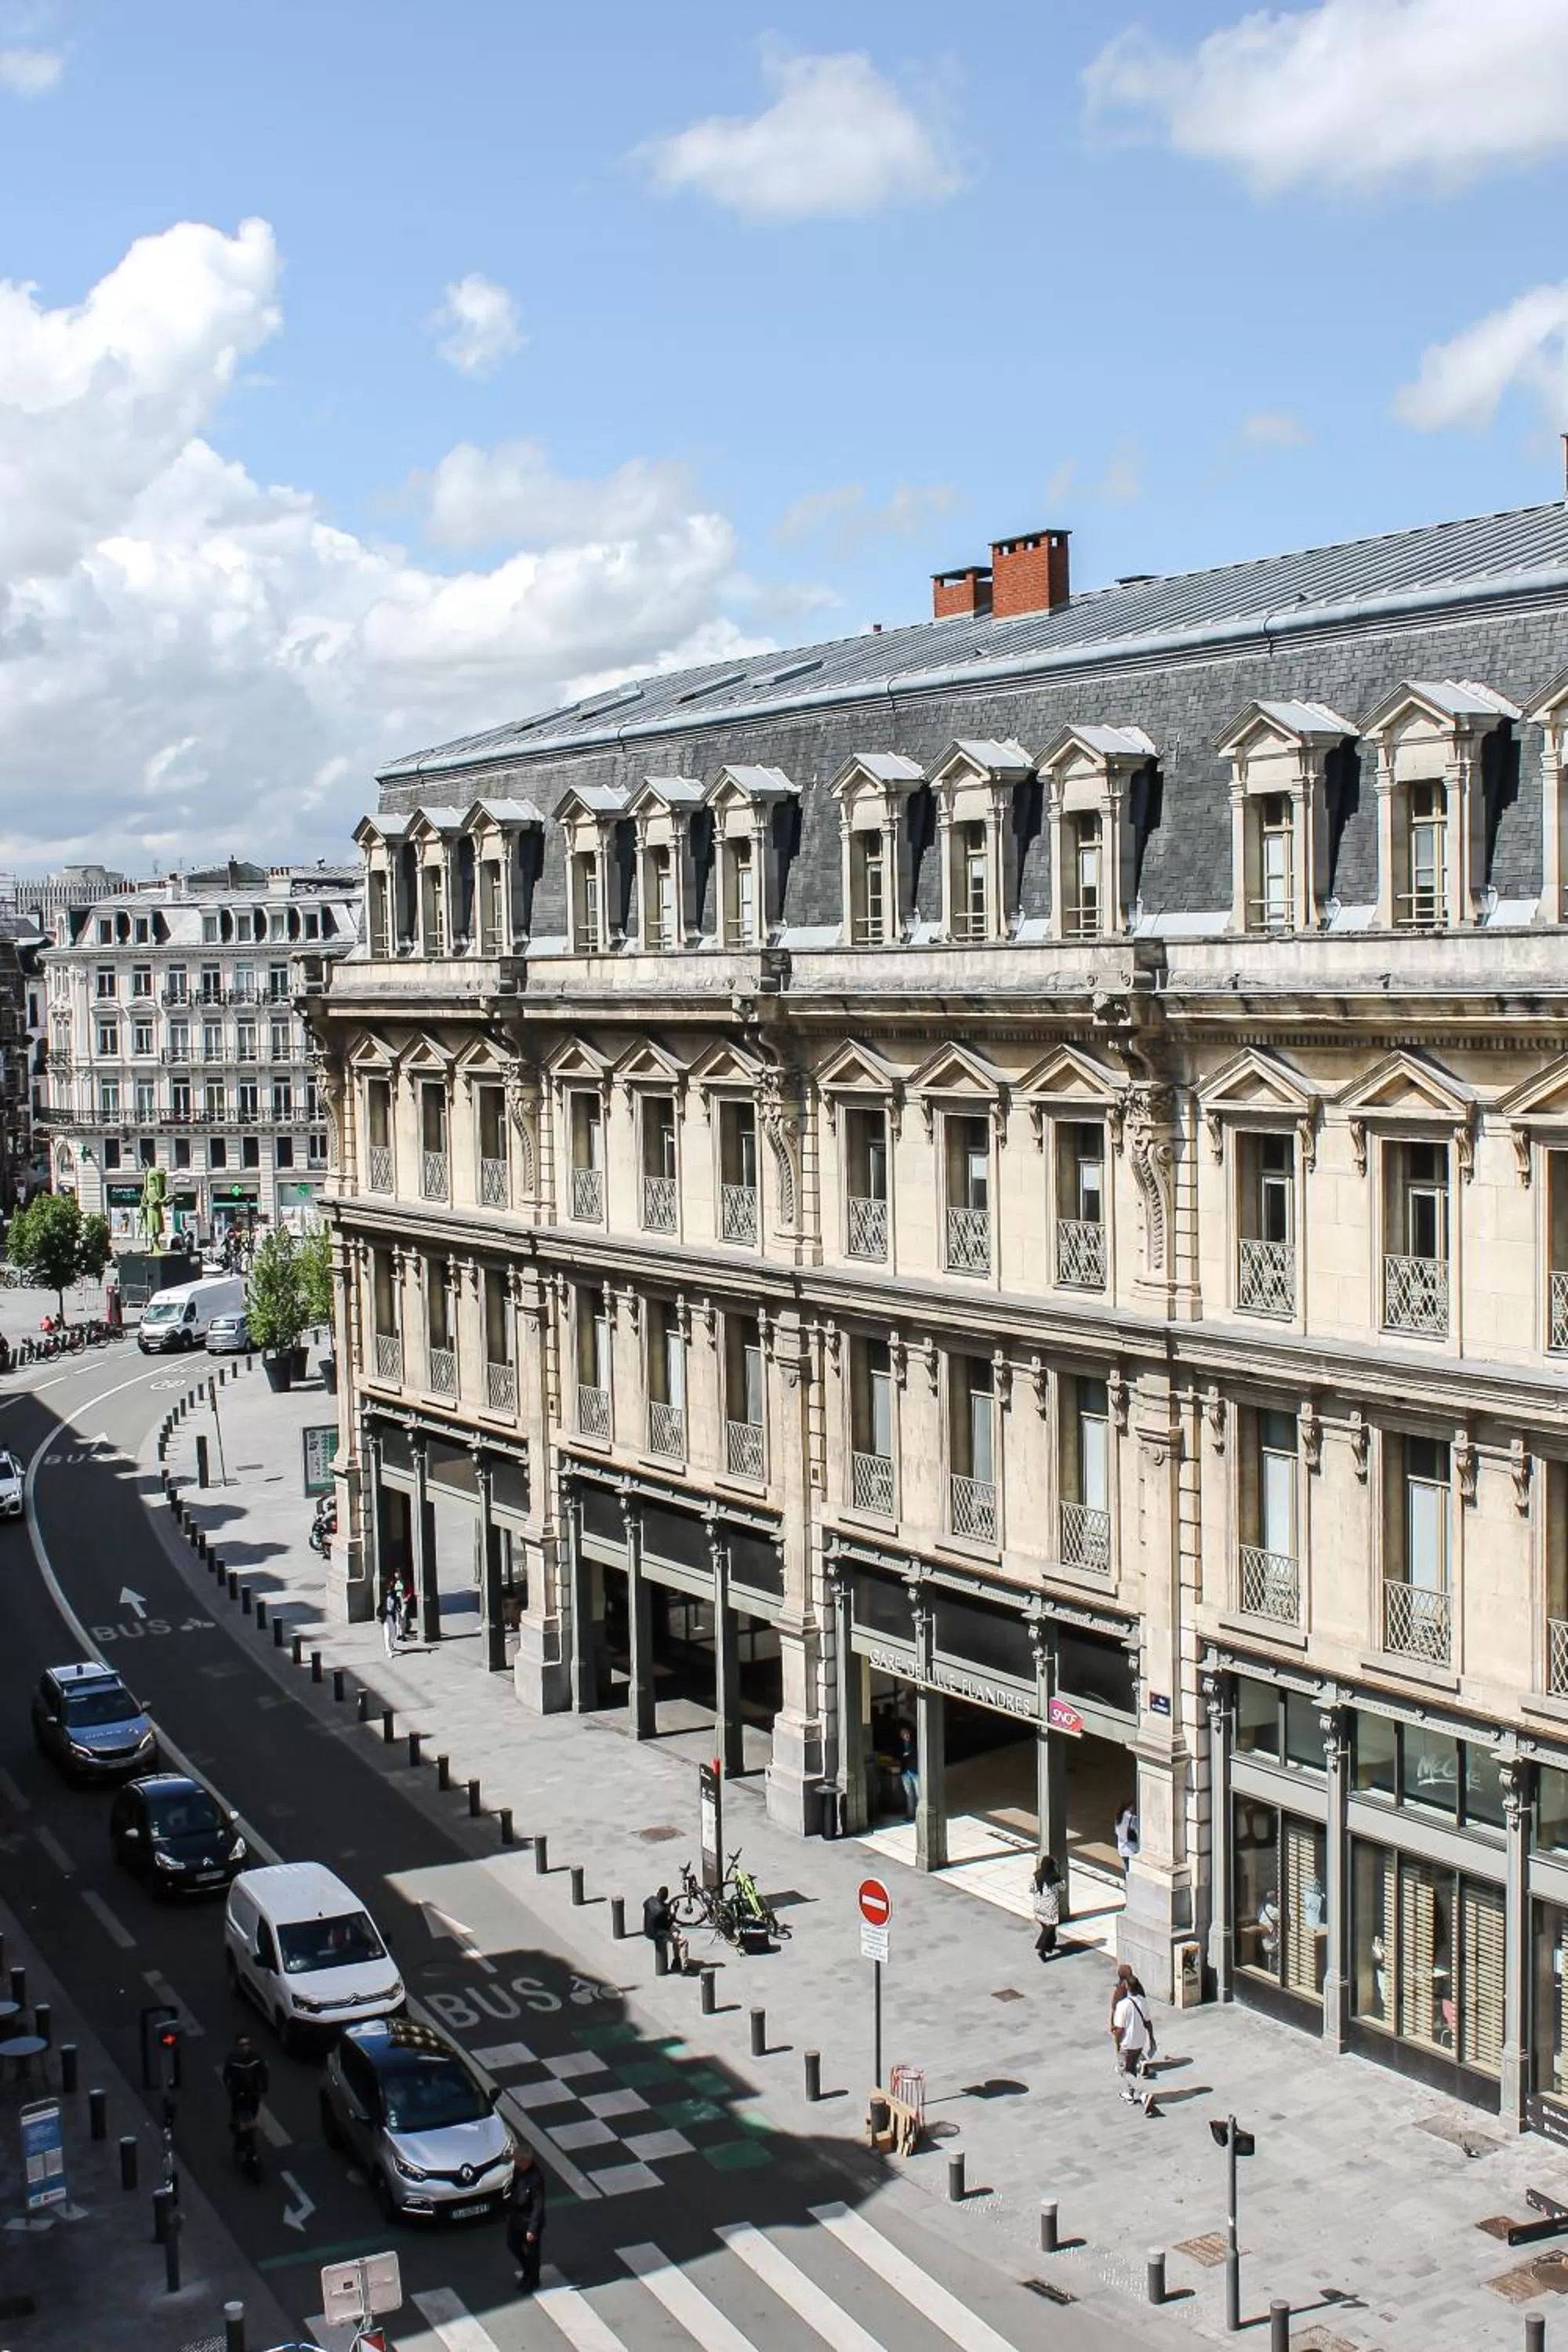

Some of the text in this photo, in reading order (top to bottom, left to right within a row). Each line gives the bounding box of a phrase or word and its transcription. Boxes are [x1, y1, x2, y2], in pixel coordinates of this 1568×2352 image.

[90, 1619, 172, 1642] BUS
[869, 1649, 1031, 1715] GARE DE LILLE FLANDRES
[1051, 1708, 1078, 1726] SNCF
[423, 1976, 563, 2030] BUS
